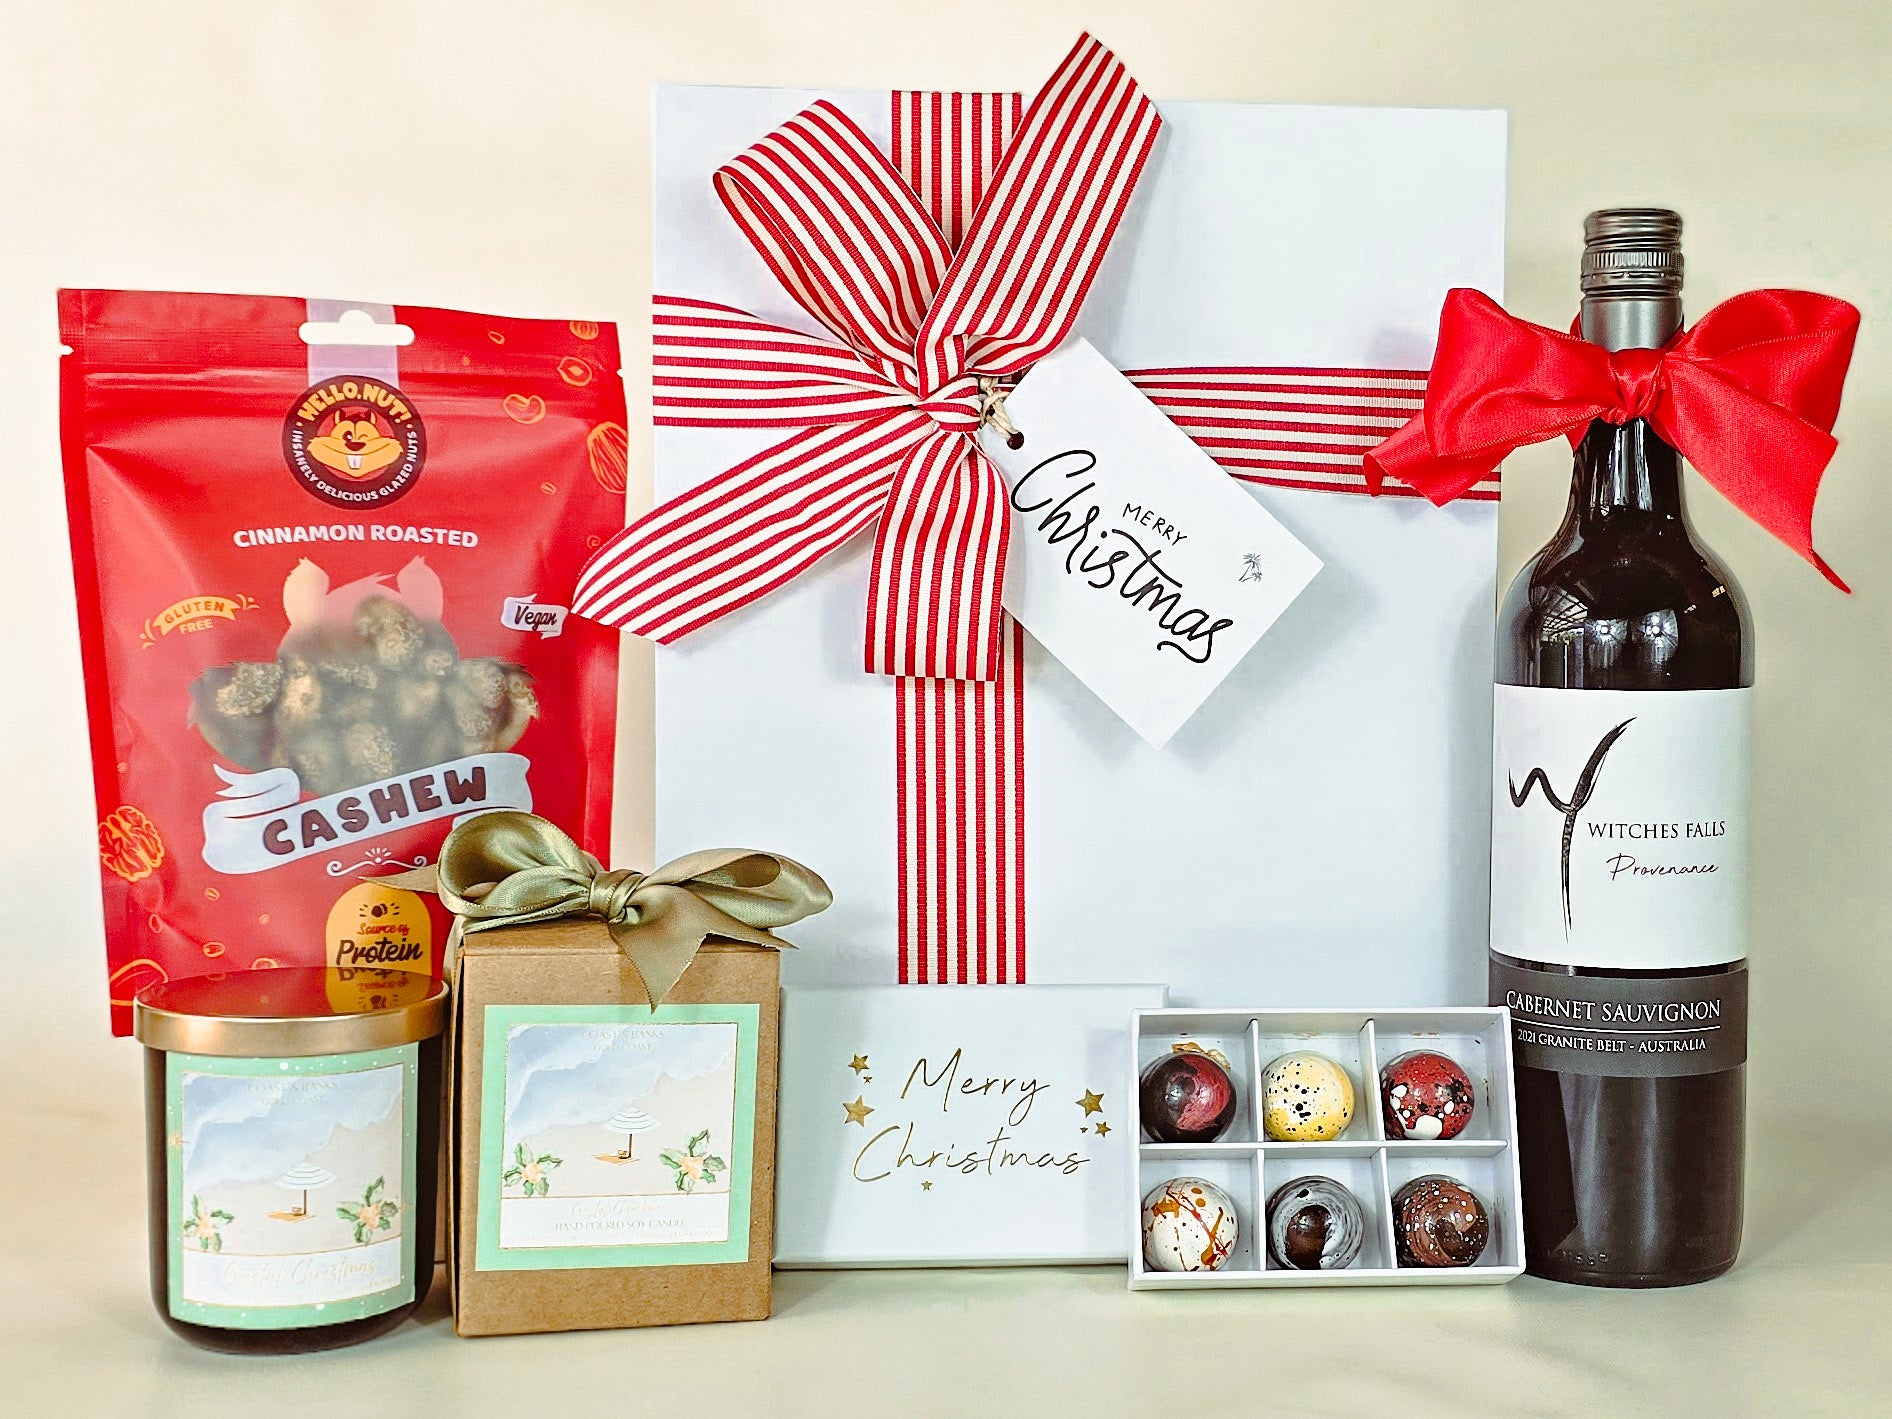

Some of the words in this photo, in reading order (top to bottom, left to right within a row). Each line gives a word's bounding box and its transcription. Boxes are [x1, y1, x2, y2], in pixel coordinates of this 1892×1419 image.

[291, 429, 319, 483] INSANELY
[316, 480, 379, 502] DELICIOUS
[379, 463, 413, 496] GLAZED
[406, 430, 418, 463] NUTS
[233, 524, 365, 549] CINNAMON
[370, 524, 479, 549] ROASTED
[1122, 502, 1188, 546] MERRY
[1010, 449, 1234, 664] Christmas
[164, 600, 225, 624] GLUTEN
[179, 618, 214, 635] FREE
[514, 605, 558, 632] Vegan
[261, 766, 488, 856] CASHEW
[1587, 822, 1679, 839] WITCHES
[1685, 820, 1726, 838] FALLS
[1605, 852, 1720, 882] Provenance
[357, 922, 397, 936] Source
[336, 936, 424, 966] Protein
[1506, 990, 1596, 1020] CABERNET
[1601, 999, 1721, 1023] SAUVIGNON
[1516, 1028, 1537, 1044] 2021
[1538, 1032, 1594, 1051] GRANITE
[1596, 1039, 1627, 1053] BELT
[1638, 1038, 1707, 1053] AUSTRALIA
[900, 1047, 1051, 1127] Merry
[852, 1121, 1091, 1183] Christmas
[555, 1221, 584, 1231] HAND
[585, 1220, 625, 1230] POURED
[626, 1220, 645, 1229] SOY
[648, 1218, 685, 1229] CANDLE
